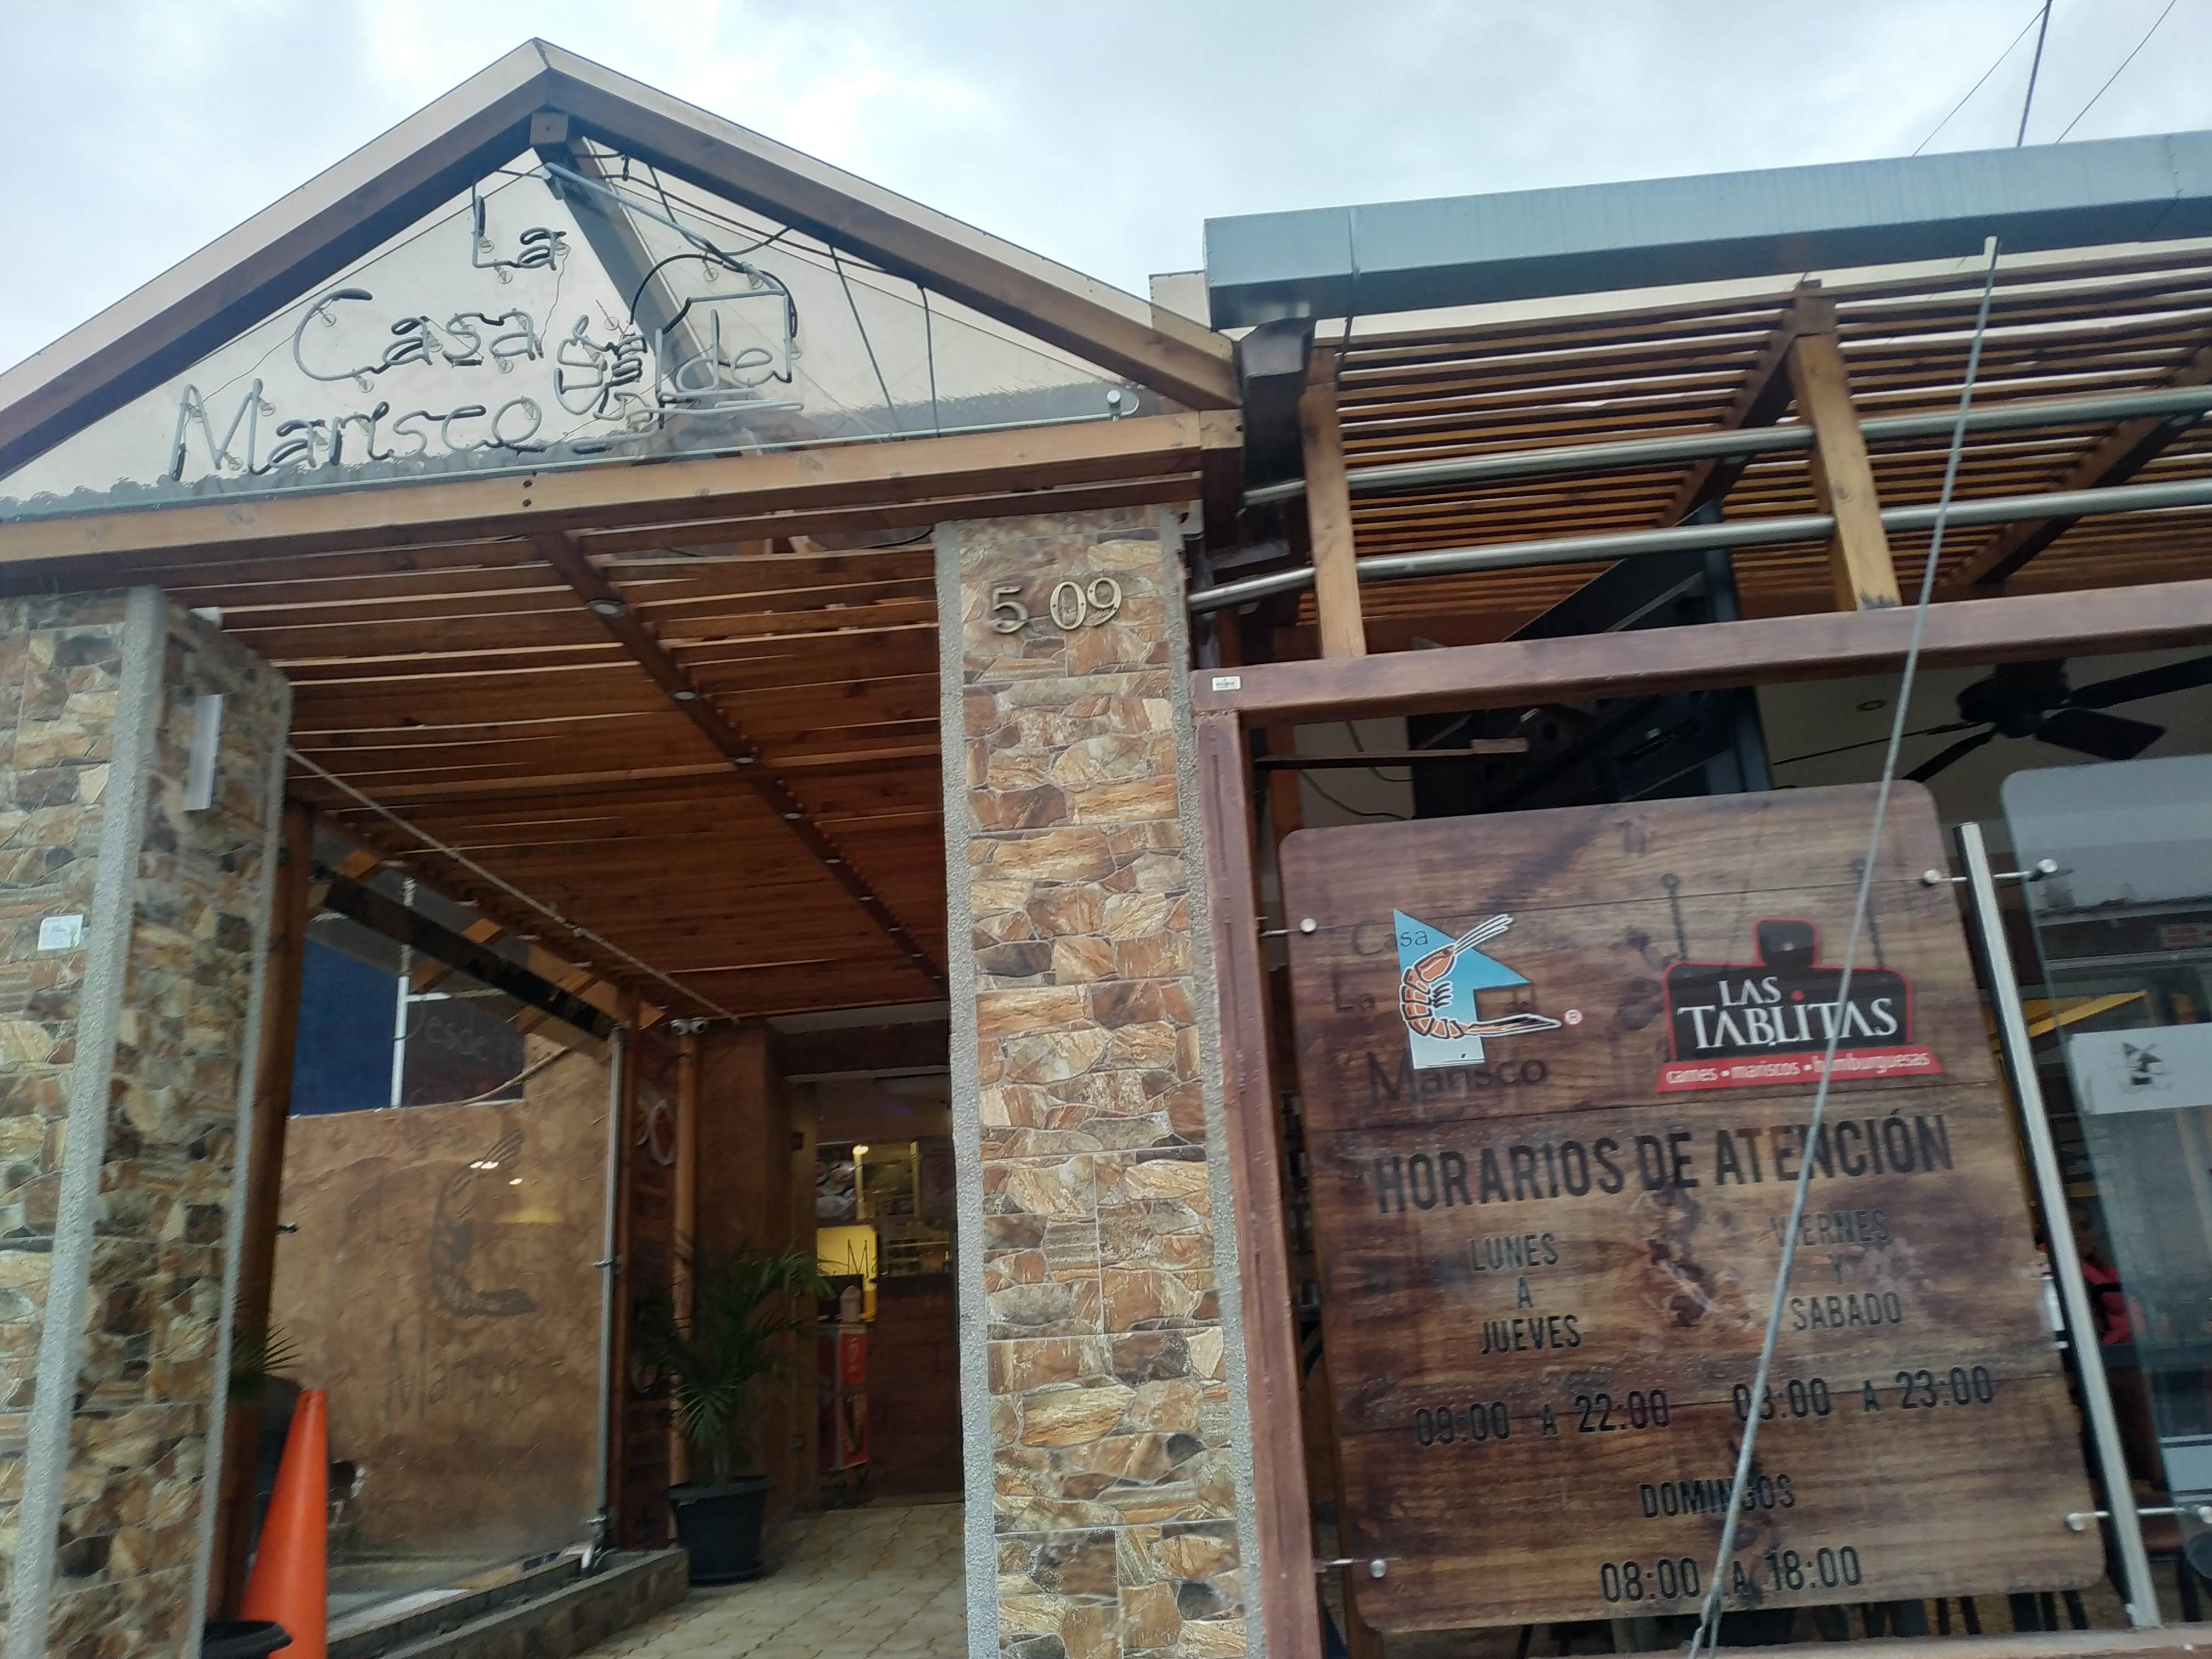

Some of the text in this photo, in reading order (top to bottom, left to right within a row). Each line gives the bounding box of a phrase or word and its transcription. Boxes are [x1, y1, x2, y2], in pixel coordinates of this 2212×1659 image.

[472, 195, 566, 271] La
[293, 287, 543, 381] Casa
[170, 378, 544, 481] Marisco
[1717, 976, 1782, 1007] LAS
[1677, 997, 1898, 1049] TABLITAS
[1812, 1052, 1931, 1074] hmburguesas
[1374, 1108, 1954, 1214] HORARIOS DE ATENCIÓN
[1767, 1208, 1891, 1248] VERNES
[1468, 1233, 1559, 1272] LUNES
[1827, 1252, 1843, 1285] Y
[1516, 1276, 1534, 1309] A
[1790, 1291, 1903, 1331] SABADO
[1482, 1314, 1581, 1355] JUEVES
[1864, 1380, 1880, 1411] A
[1896, 1365, 1993, 1409] 23:00
[1575, 1389, 1670, 1433] 22:00
[1601, 1546, 1863, 1603] 08:00 A 18:00
